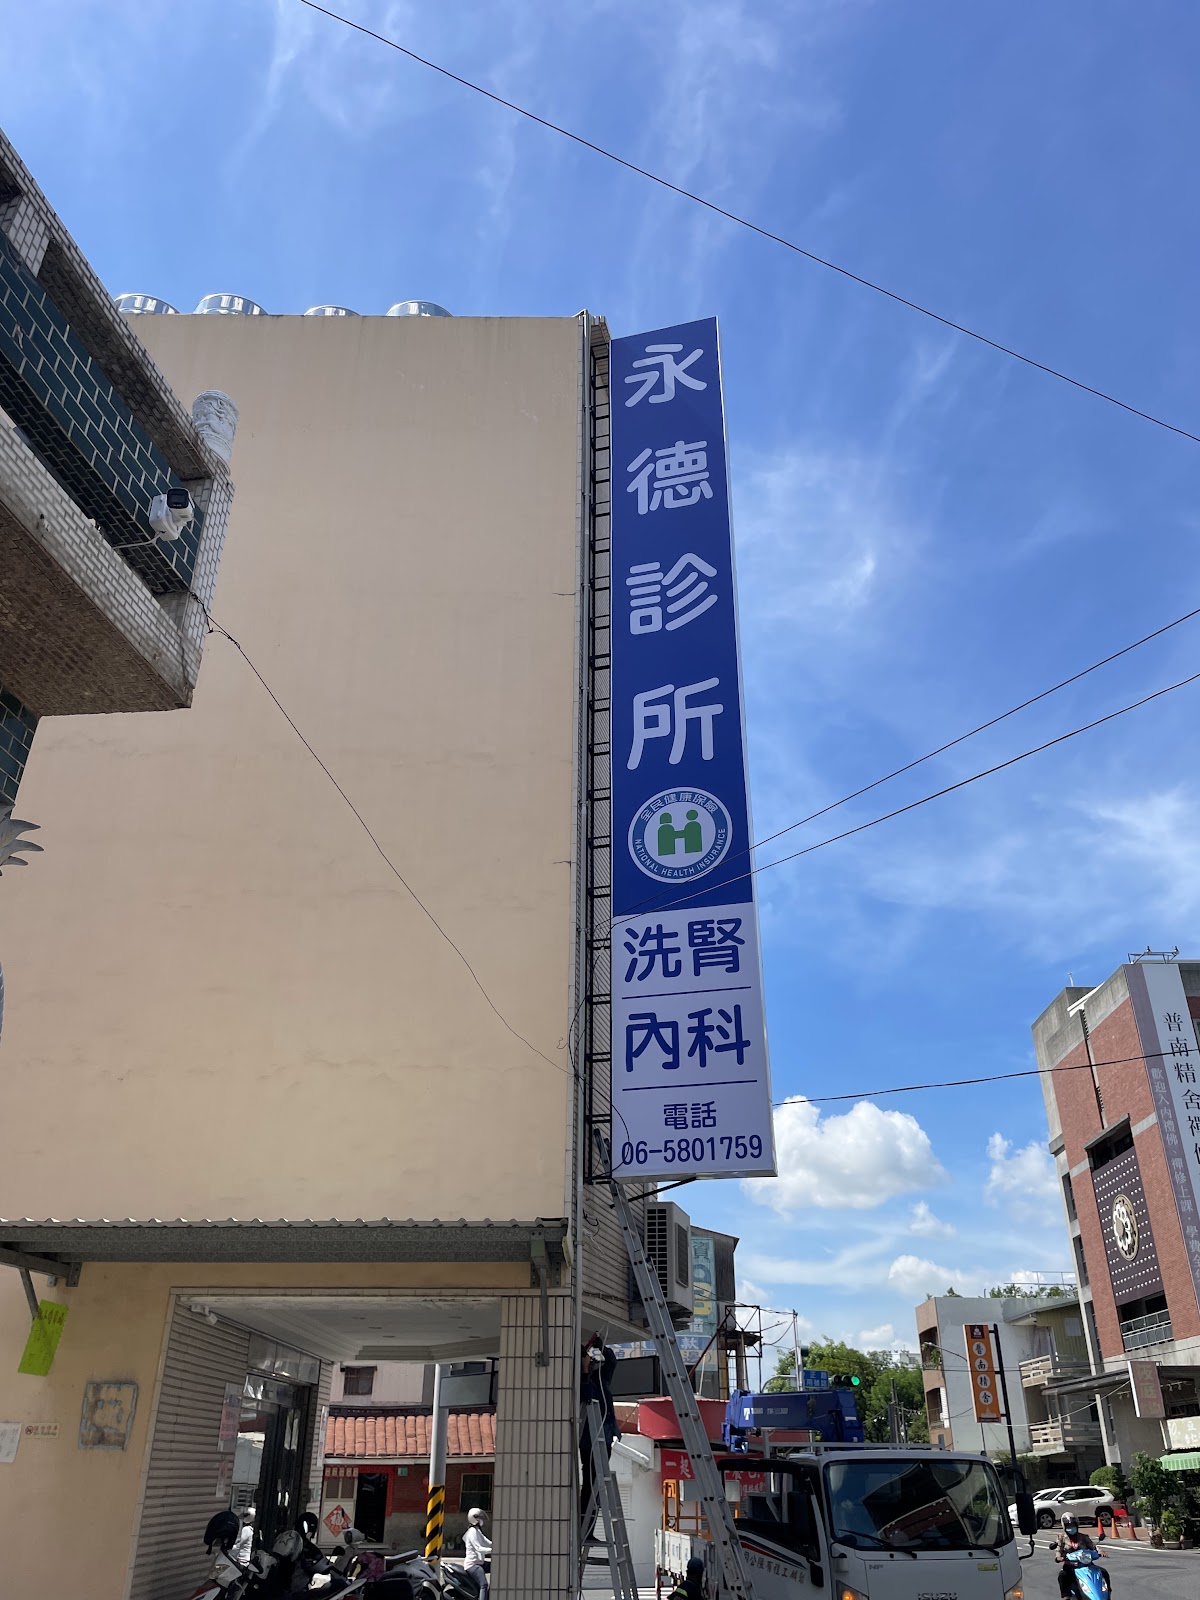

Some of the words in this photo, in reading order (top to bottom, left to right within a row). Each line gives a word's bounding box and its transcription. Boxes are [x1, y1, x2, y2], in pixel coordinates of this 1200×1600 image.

[624, 343, 724, 771] 永德診所
[640, 792, 718, 822] 全民健康保險
[634, 838, 659, 873] NATIONAL
[661, 867, 695, 877] HEALTH
[697, 828, 726, 871] INSURANCE
[623, 918, 746, 982] 洗腎
[663, 1100, 717, 1129] 電話
[621, 1134, 763, 1165] 06-5801759
